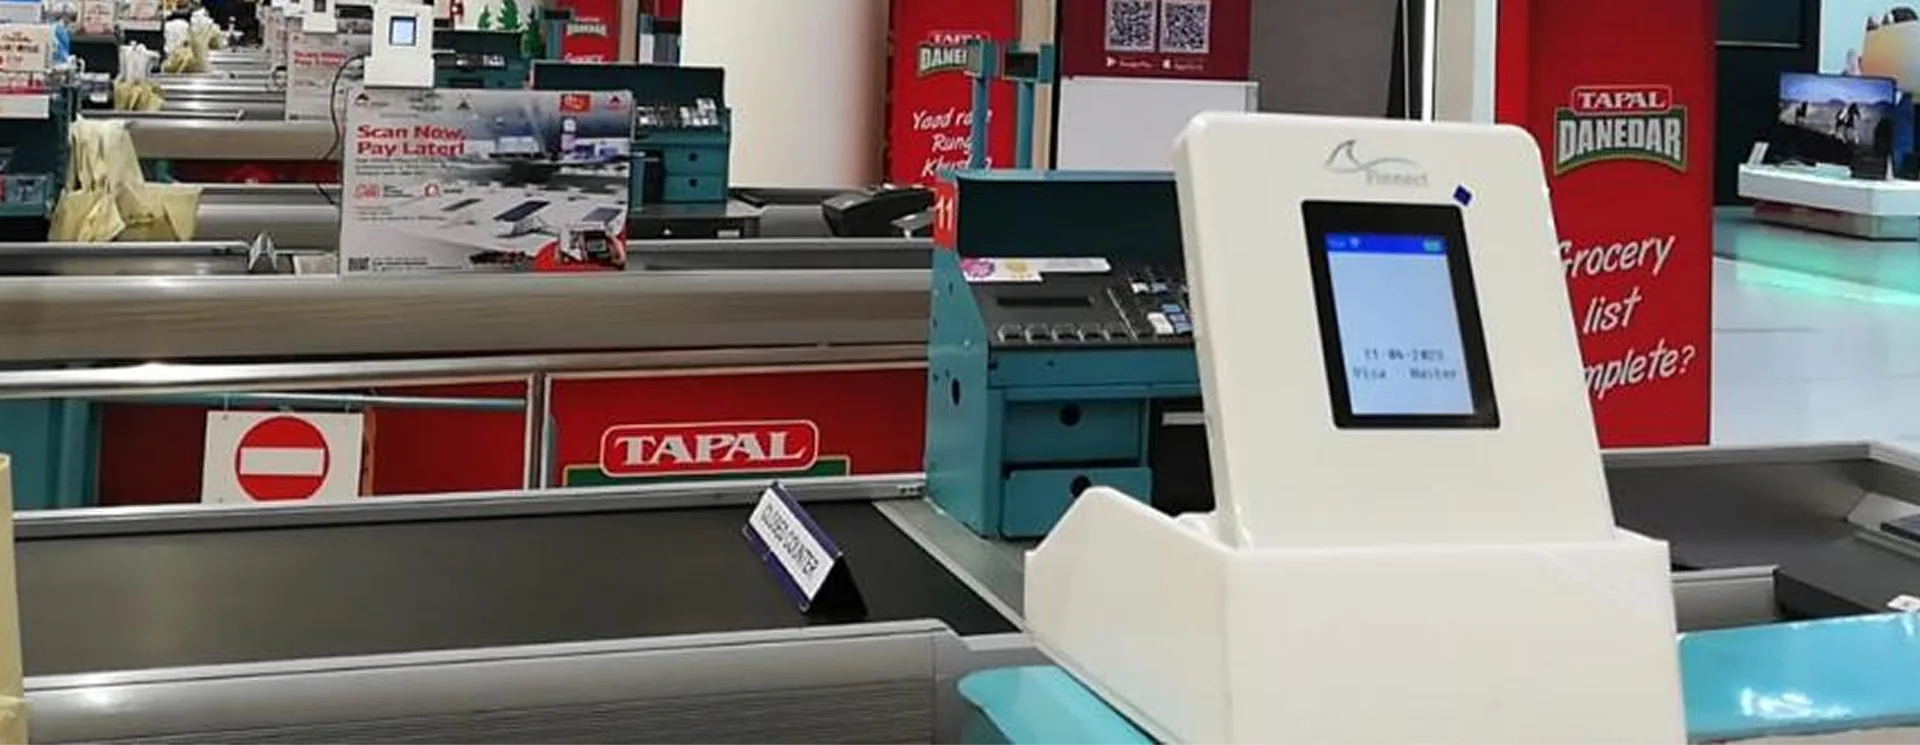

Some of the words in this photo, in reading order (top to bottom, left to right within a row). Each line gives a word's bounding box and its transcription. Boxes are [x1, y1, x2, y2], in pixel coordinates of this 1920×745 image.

[1577, 91, 1666, 109] TAPAL
[357, 124, 408, 139] Scan
[414, 125, 466, 141] Now,
[357, 141, 397, 157] Pay
[403, 142, 465, 156] Later!
[1559, 117, 1681, 163] DANEDAR
[935, 195, 953, 230] 11
[1583, 286, 1643, 334] list
[1584, 338, 1696, 400] mplete?
[613, 430, 807, 466] TAPAL
